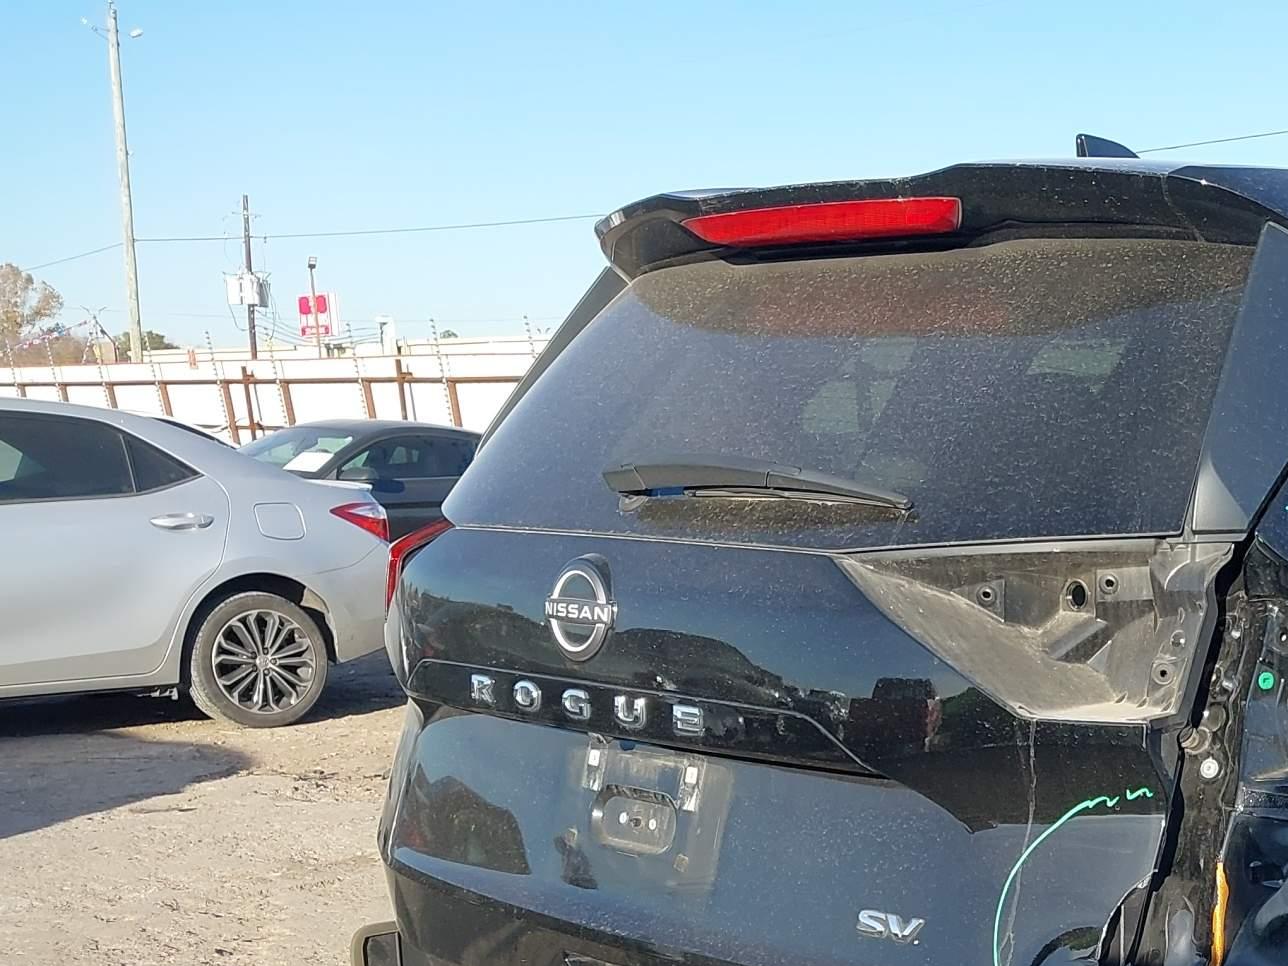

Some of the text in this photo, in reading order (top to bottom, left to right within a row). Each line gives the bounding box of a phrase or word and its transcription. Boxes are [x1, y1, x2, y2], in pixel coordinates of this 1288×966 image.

[545, 601, 609, 622] NISSAN
[471, 673, 705, 737] ROGUE
[857, 909, 925, 943] SV
